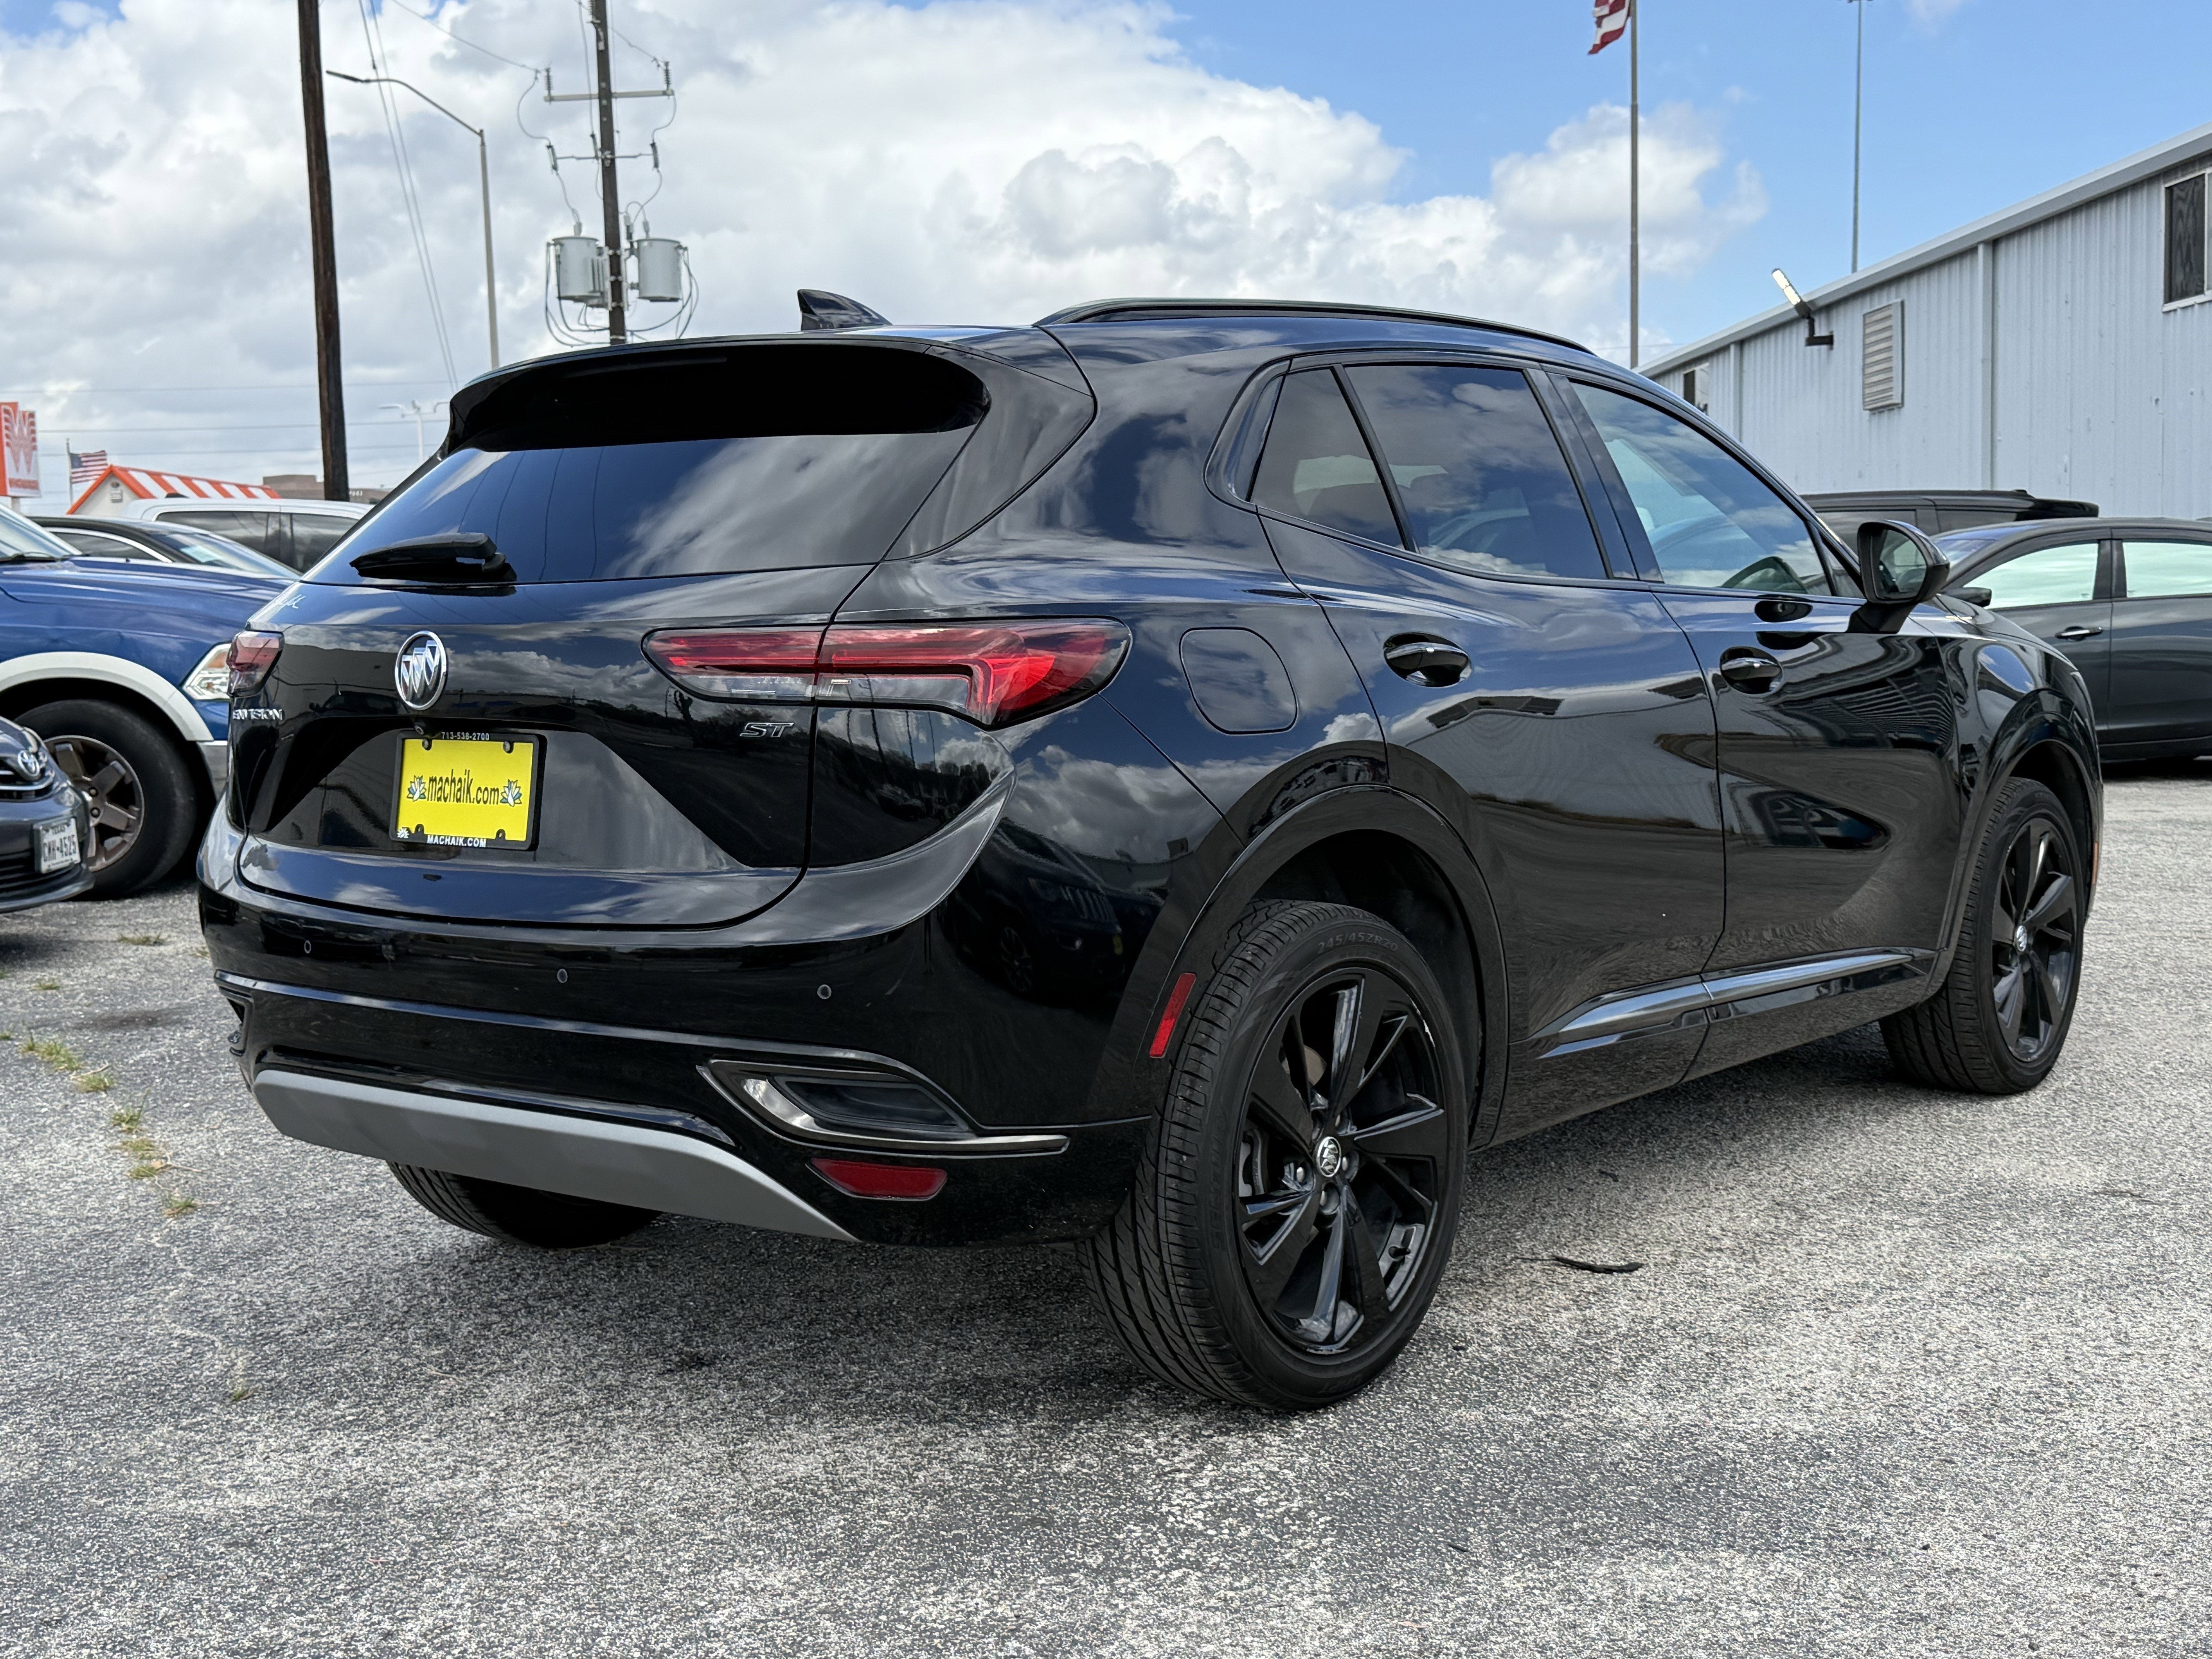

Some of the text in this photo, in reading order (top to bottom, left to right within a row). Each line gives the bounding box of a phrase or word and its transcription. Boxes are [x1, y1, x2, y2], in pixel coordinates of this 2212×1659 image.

[441, 731, 489, 741] 713-538-2700
[739, 722, 795, 738] ST
[427, 768, 500, 805] machaik.com
[427, 834, 487, 848] MACHAIK.COM
[1317, 932, 1399, 955] 245/45ZR20
